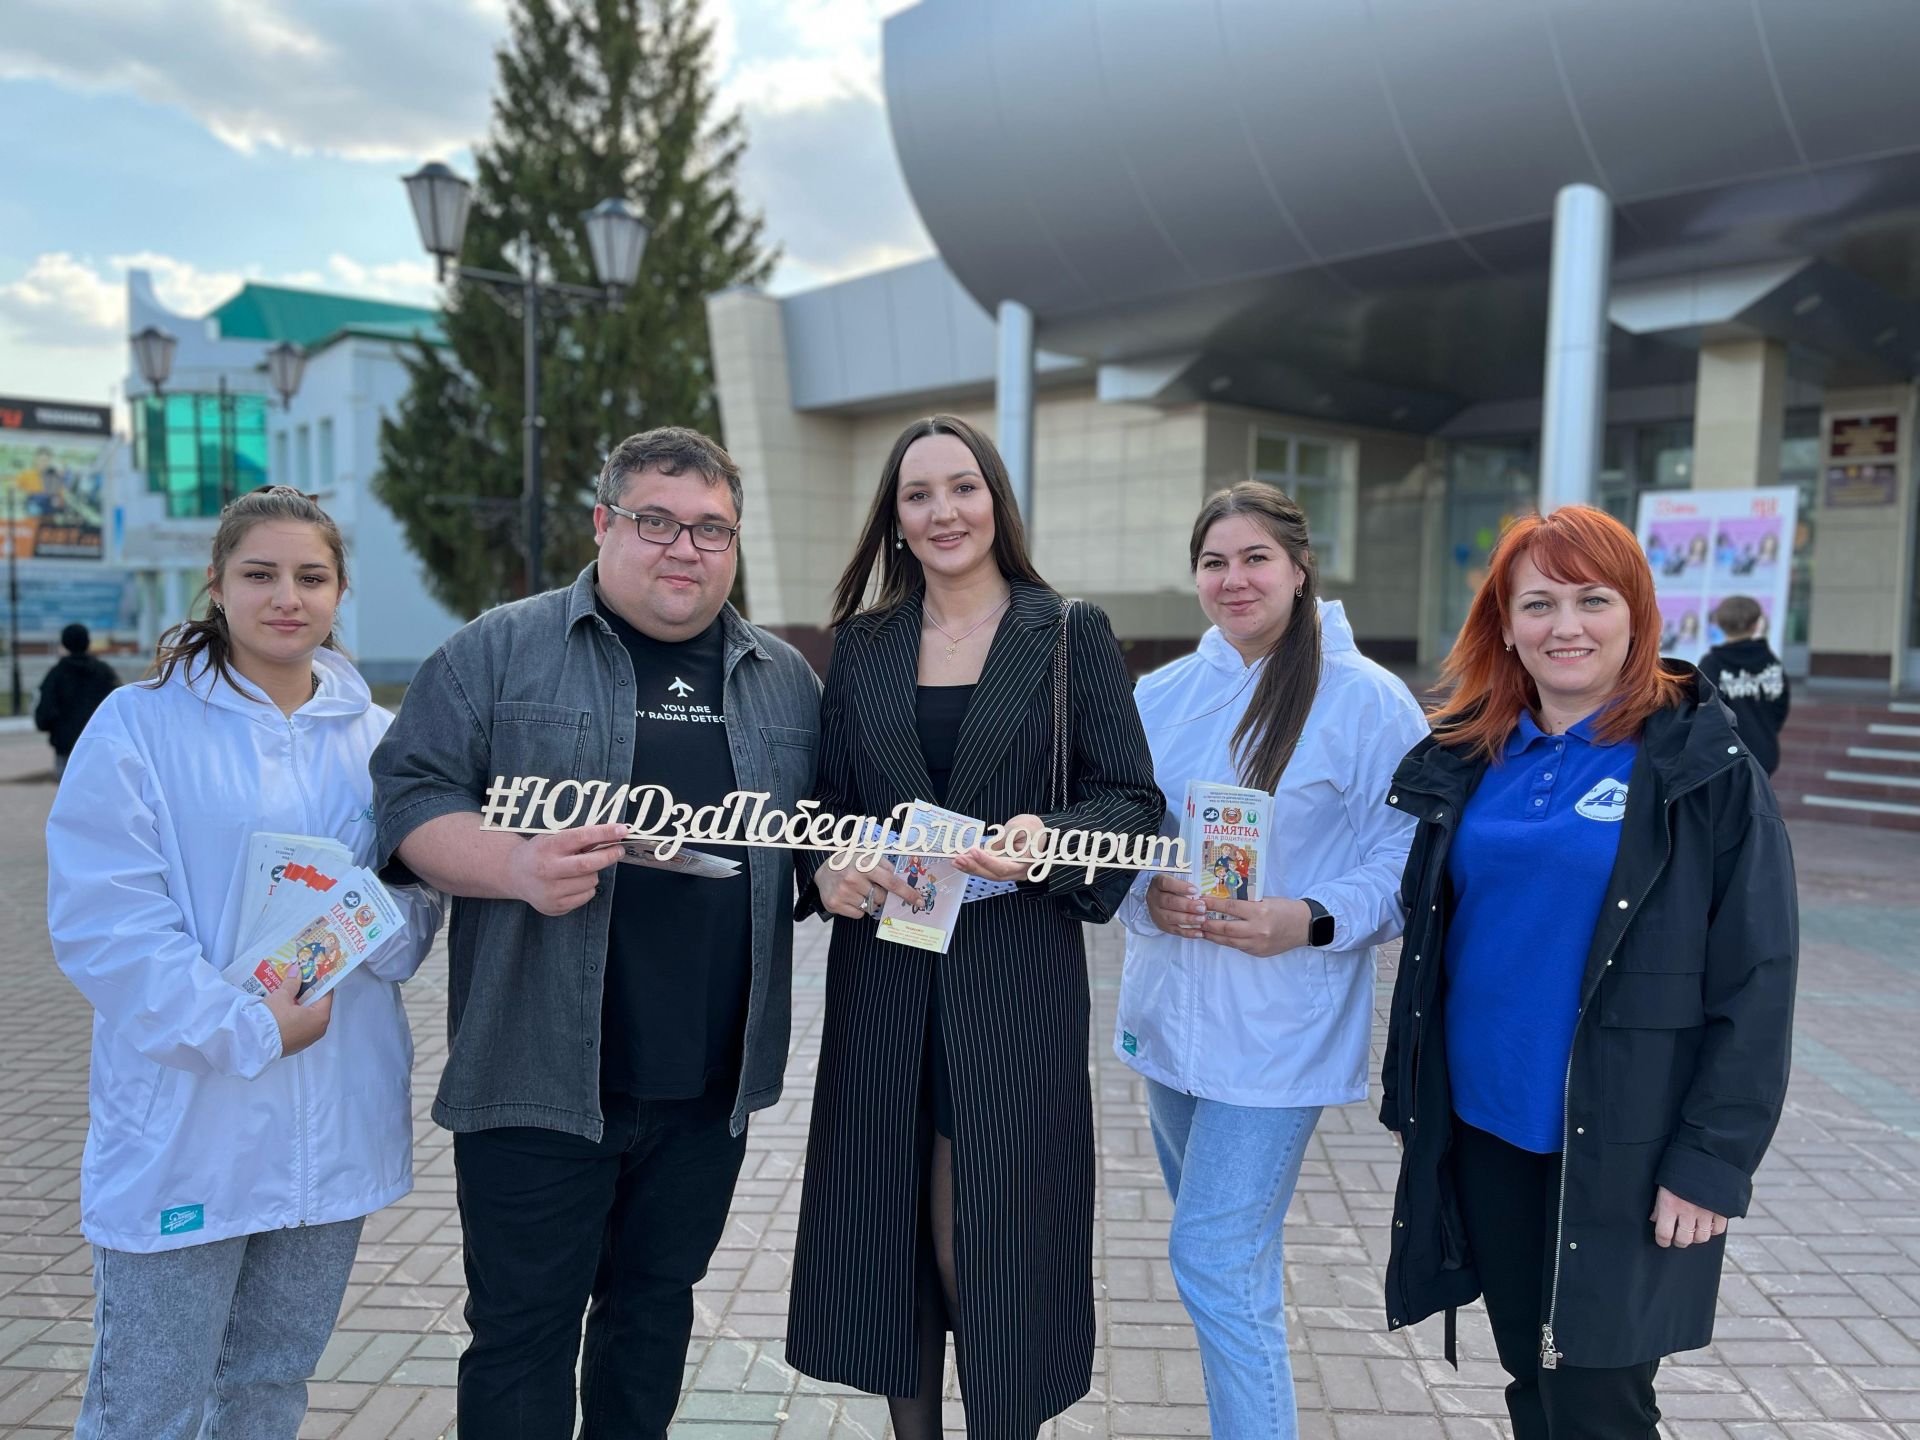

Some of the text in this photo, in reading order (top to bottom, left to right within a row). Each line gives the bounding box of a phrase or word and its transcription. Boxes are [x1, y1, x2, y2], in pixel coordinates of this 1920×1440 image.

[661, 703, 712, 713] YOU ARE
[648, 711, 688, 722] RADAR
[1204, 825, 1259, 837] ПАМЯТКА
[330, 902, 368, 953] ПАМЯТКА
[263, 965, 283, 988] Безоп
